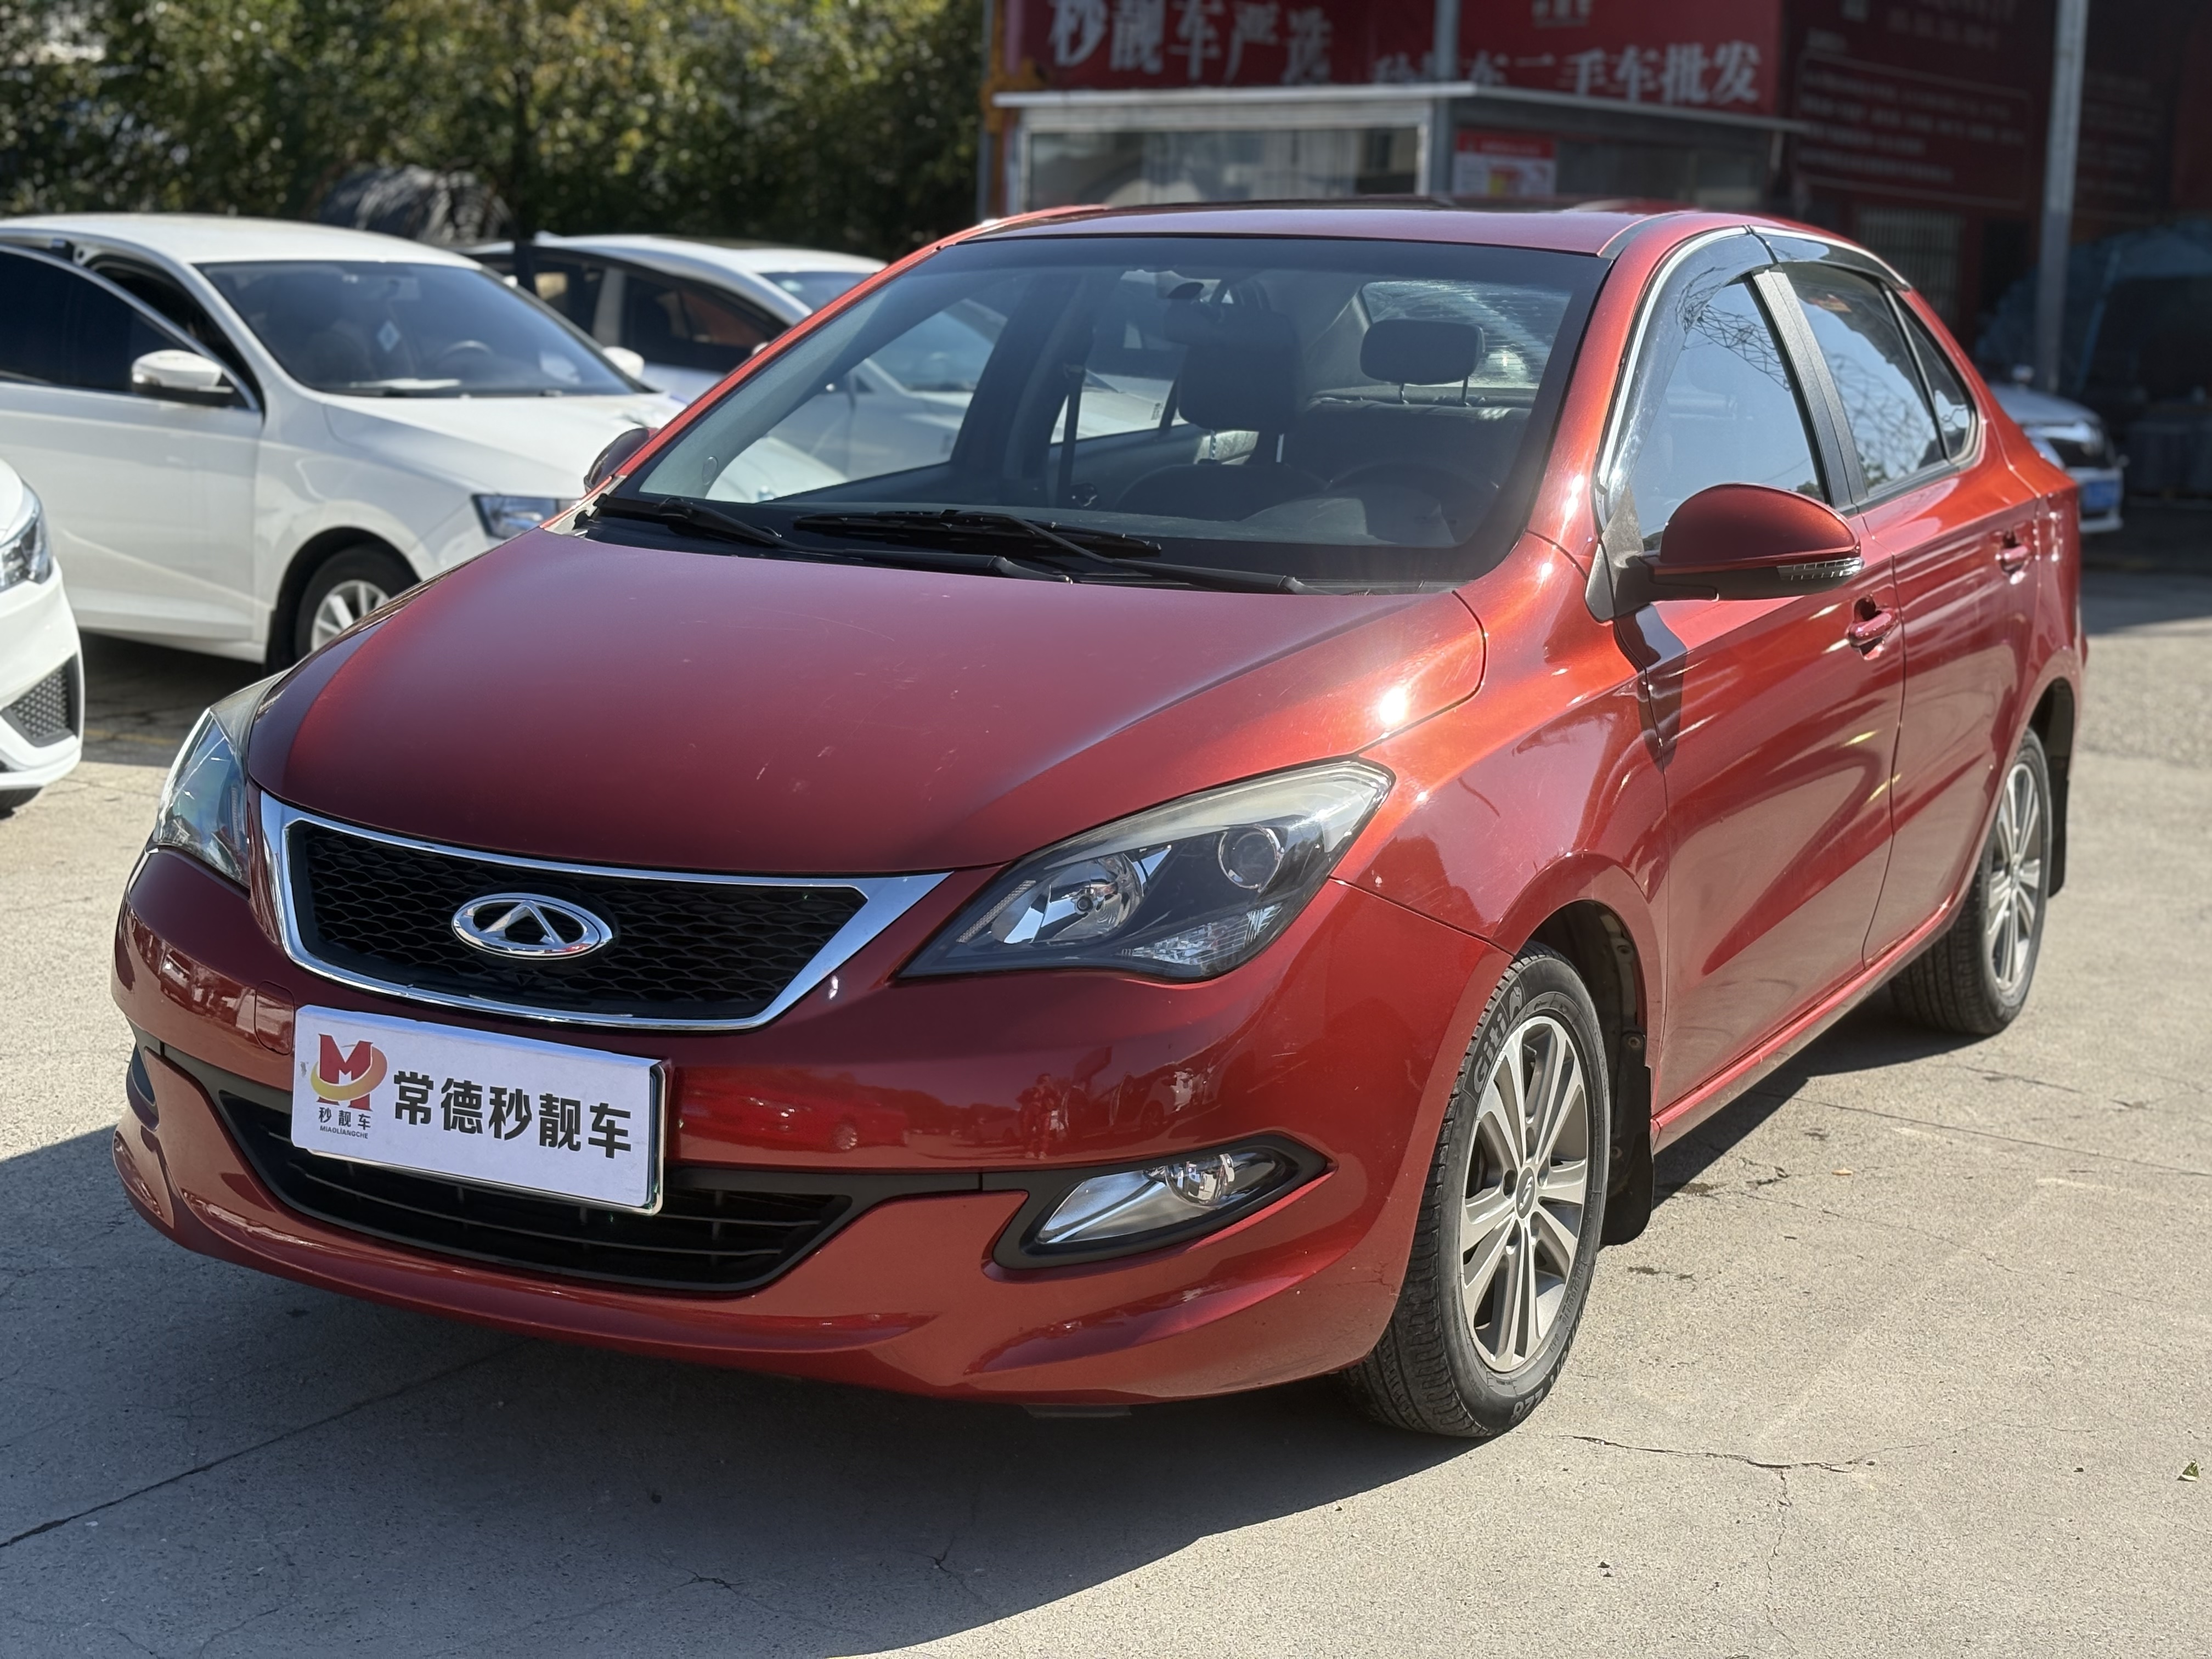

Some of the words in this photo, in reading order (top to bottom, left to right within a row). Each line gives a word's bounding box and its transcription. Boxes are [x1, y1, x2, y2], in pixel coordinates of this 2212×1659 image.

[318, 1107, 371, 1131] 秒靓车
[394, 1070, 631, 1159] 常德秒靓车
[320, 1125, 368, 1139] MIAOLIANGCHE
